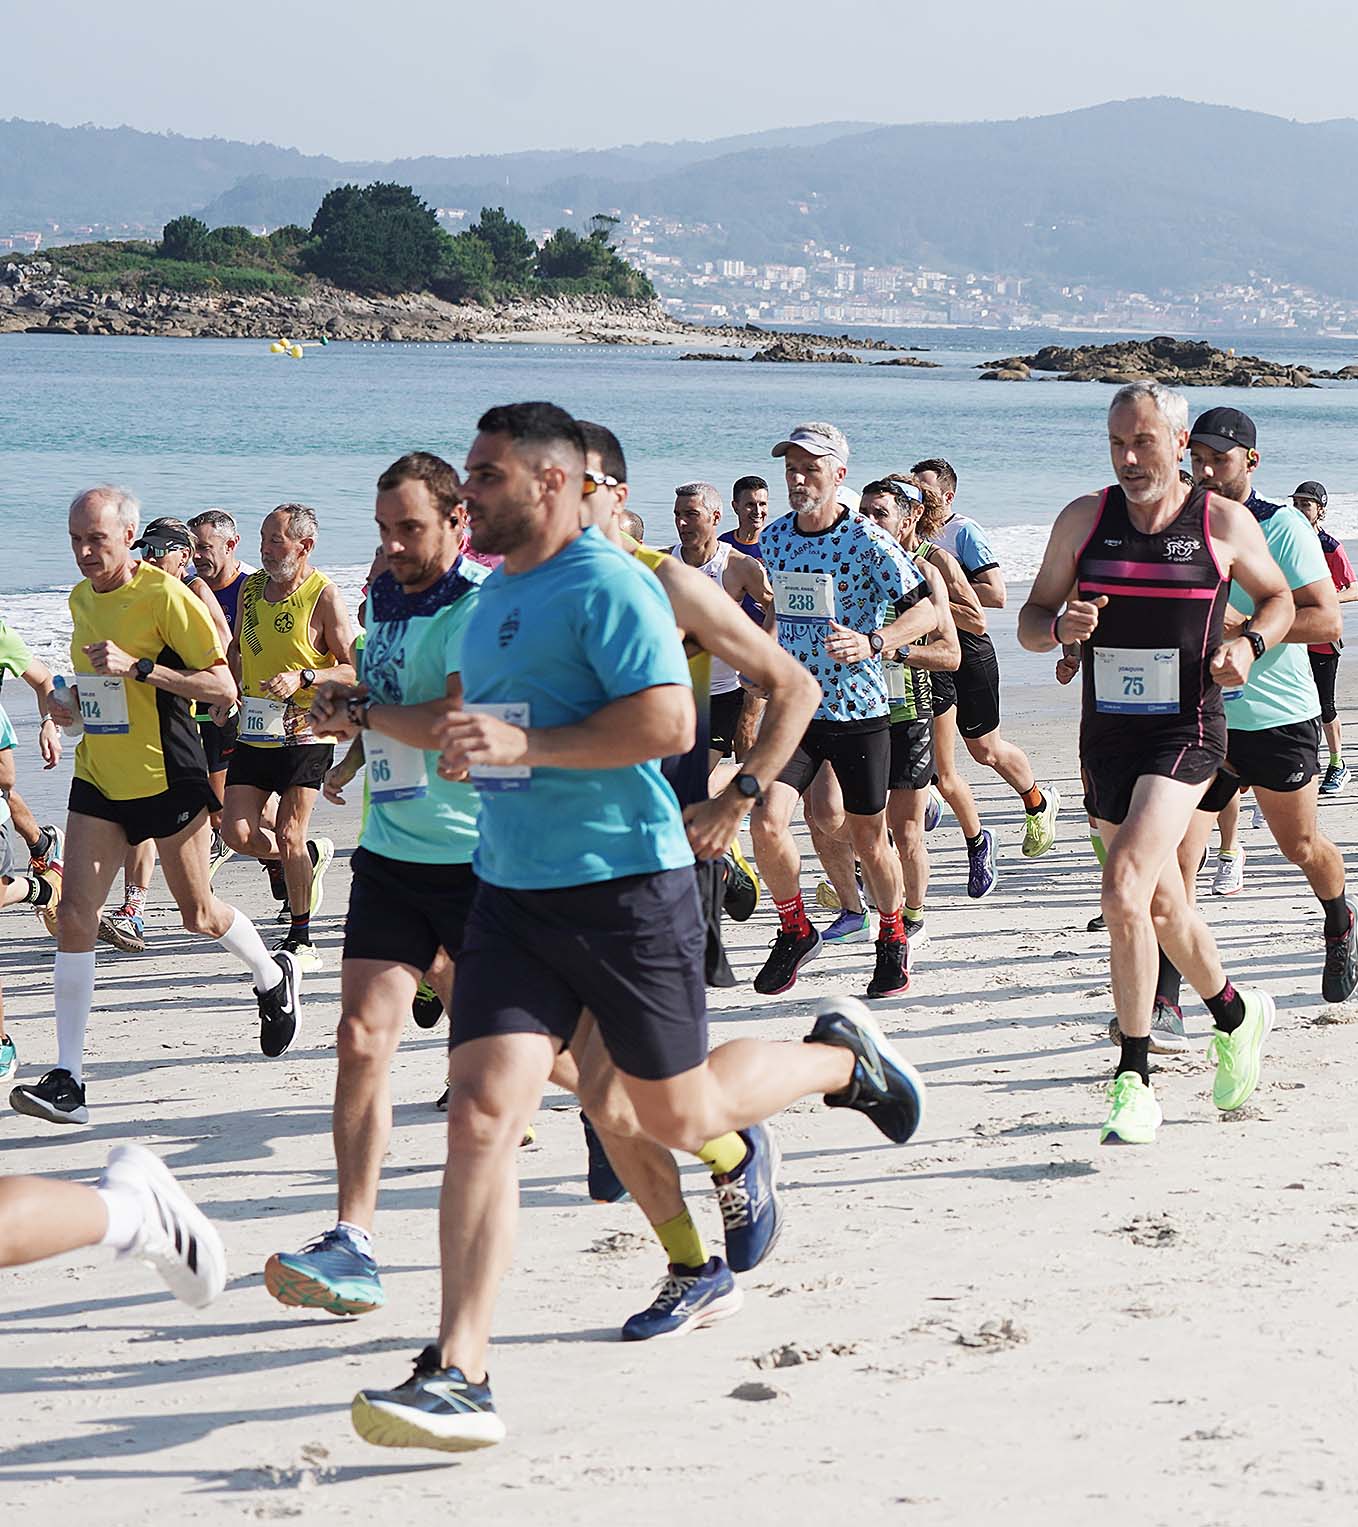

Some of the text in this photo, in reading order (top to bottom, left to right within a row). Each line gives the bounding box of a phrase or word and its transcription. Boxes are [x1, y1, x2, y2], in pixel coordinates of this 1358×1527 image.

[788, 593, 815, 611] 238
[1122, 675, 1145, 696] 75
[80, 700, 102, 718] 114
[247, 715, 264, 731] 116
[371, 759, 391, 783] 66
